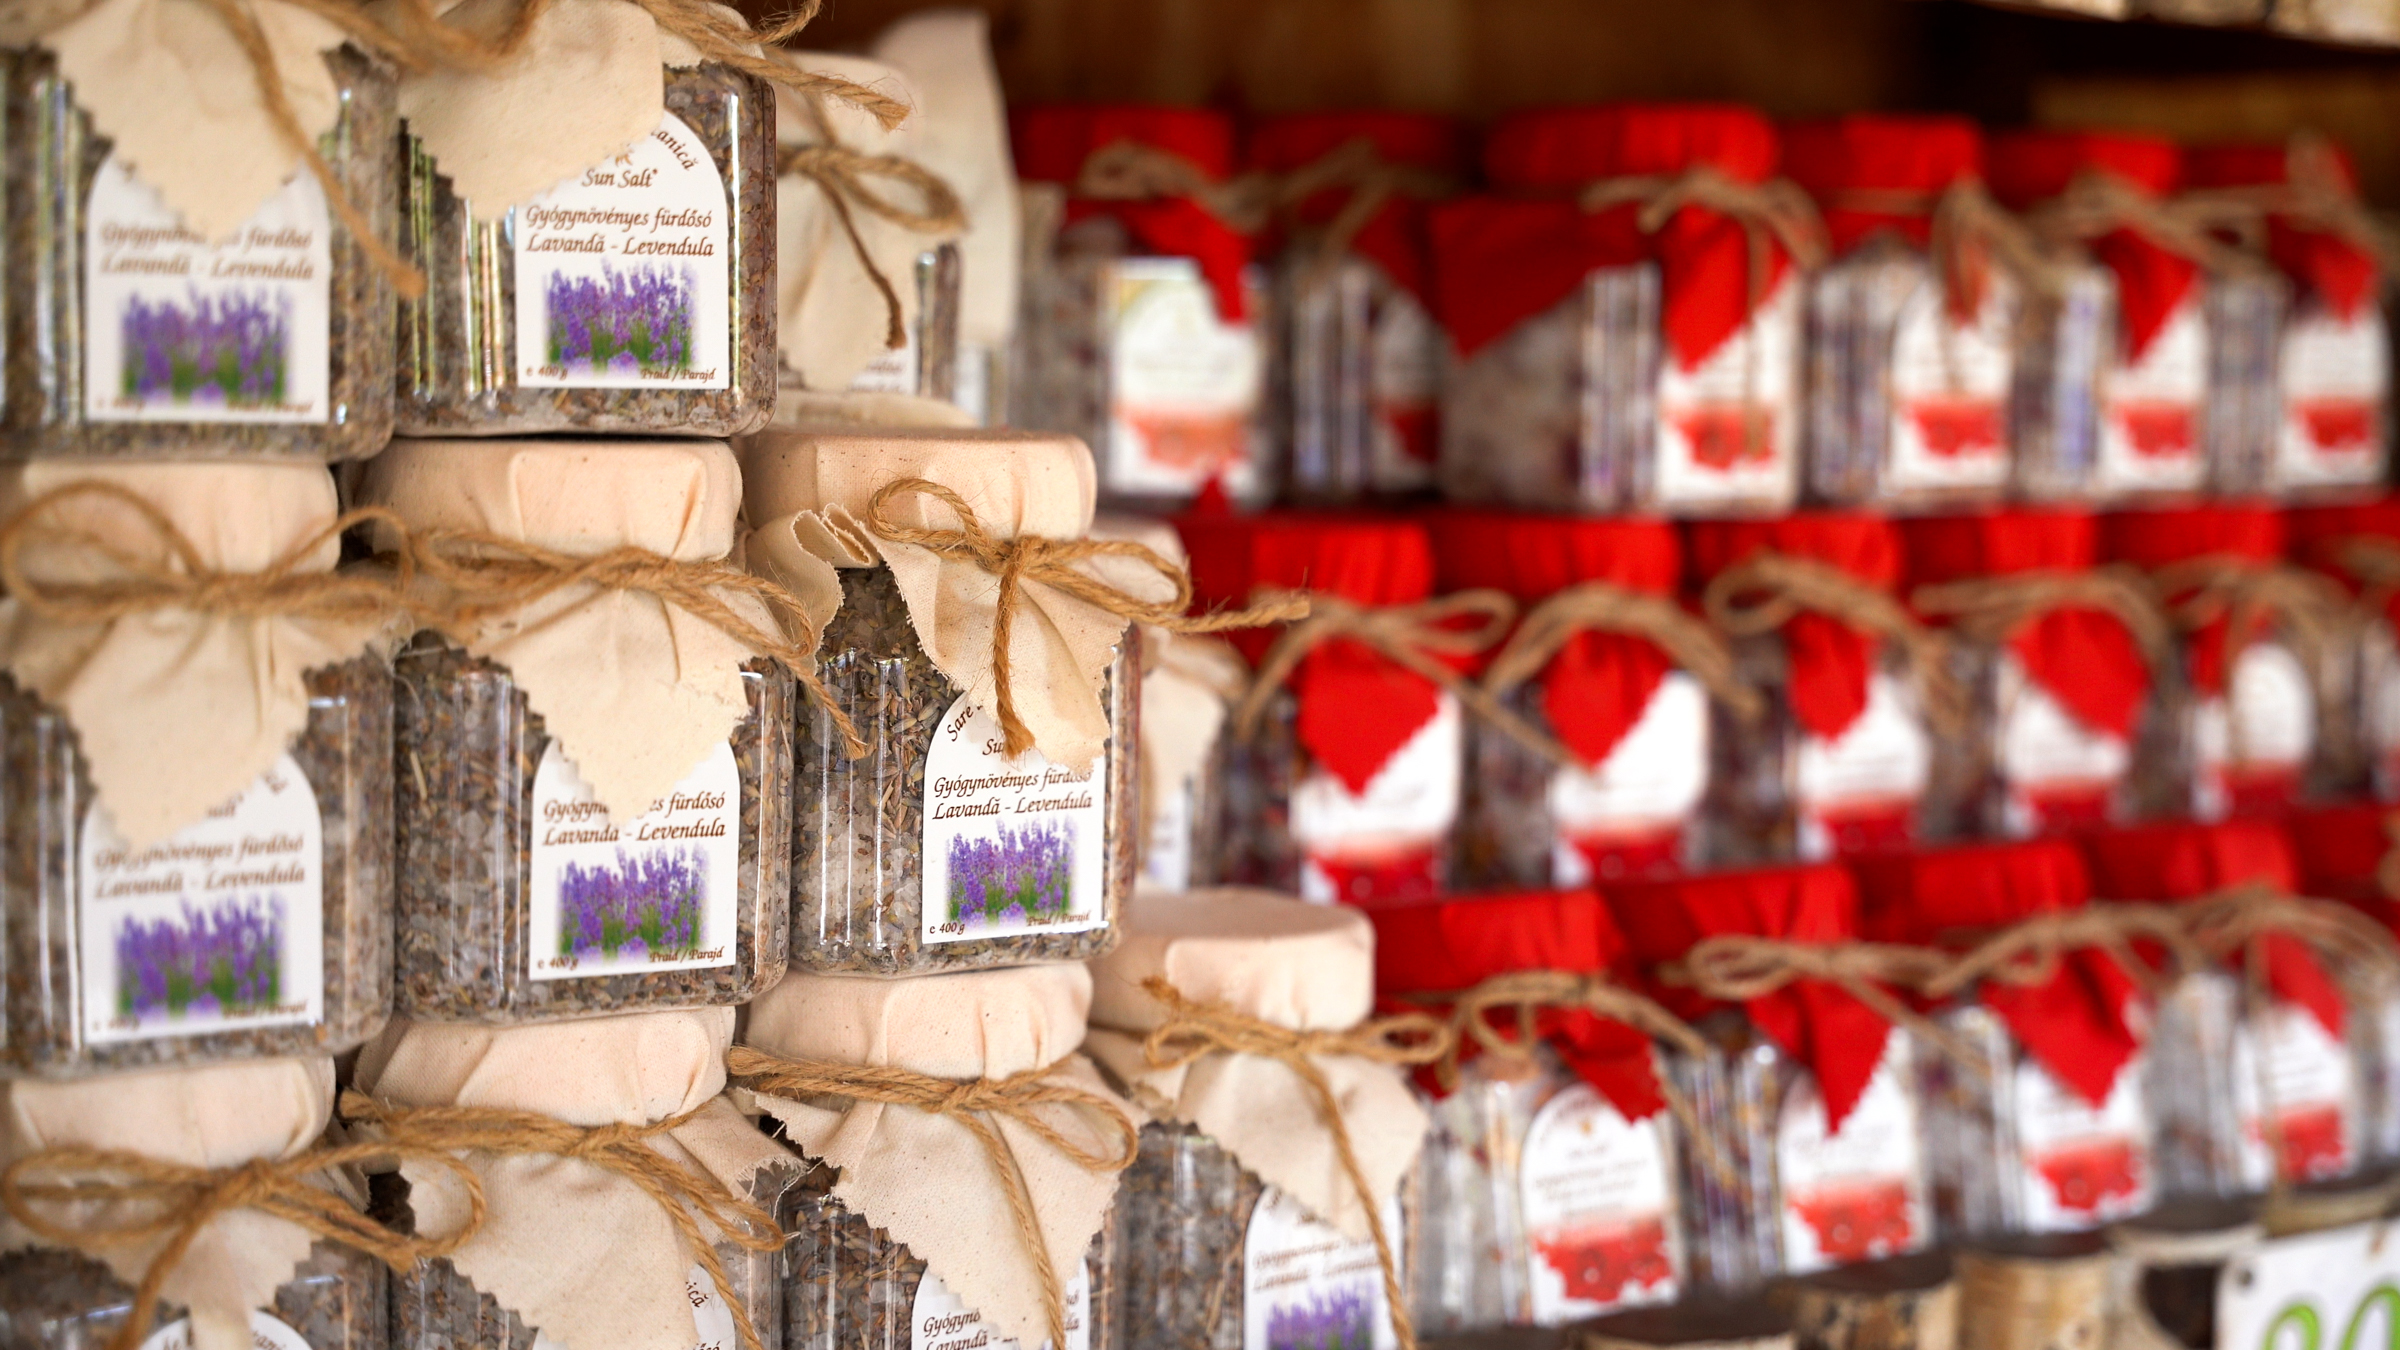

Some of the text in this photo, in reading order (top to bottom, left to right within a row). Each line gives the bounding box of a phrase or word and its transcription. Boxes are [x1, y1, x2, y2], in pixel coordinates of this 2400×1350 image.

[651, 130, 699, 170] anică
[582, 168, 615, 187] Sun
[526, 204, 712, 233] Gyógynövényes fürdősó
[622, 236, 715, 256] Levendula
[681, 368, 716, 383] Parajd
[947, 705, 974, 742] Sare
[934, 771, 1039, 799] Gyógynövényes
[665, 791, 726, 818] fürdősó
[1014, 790, 1093, 814] Levendula
[636, 817, 727, 841] Levendula
[939, 923, 957, 934] 400
[957, 923, 966, 935] g
[650, 950, 678, 962] Praid
[689, 946, 725, 962] Parajd
[923, 1308, 981, 1338] Gyógynö
